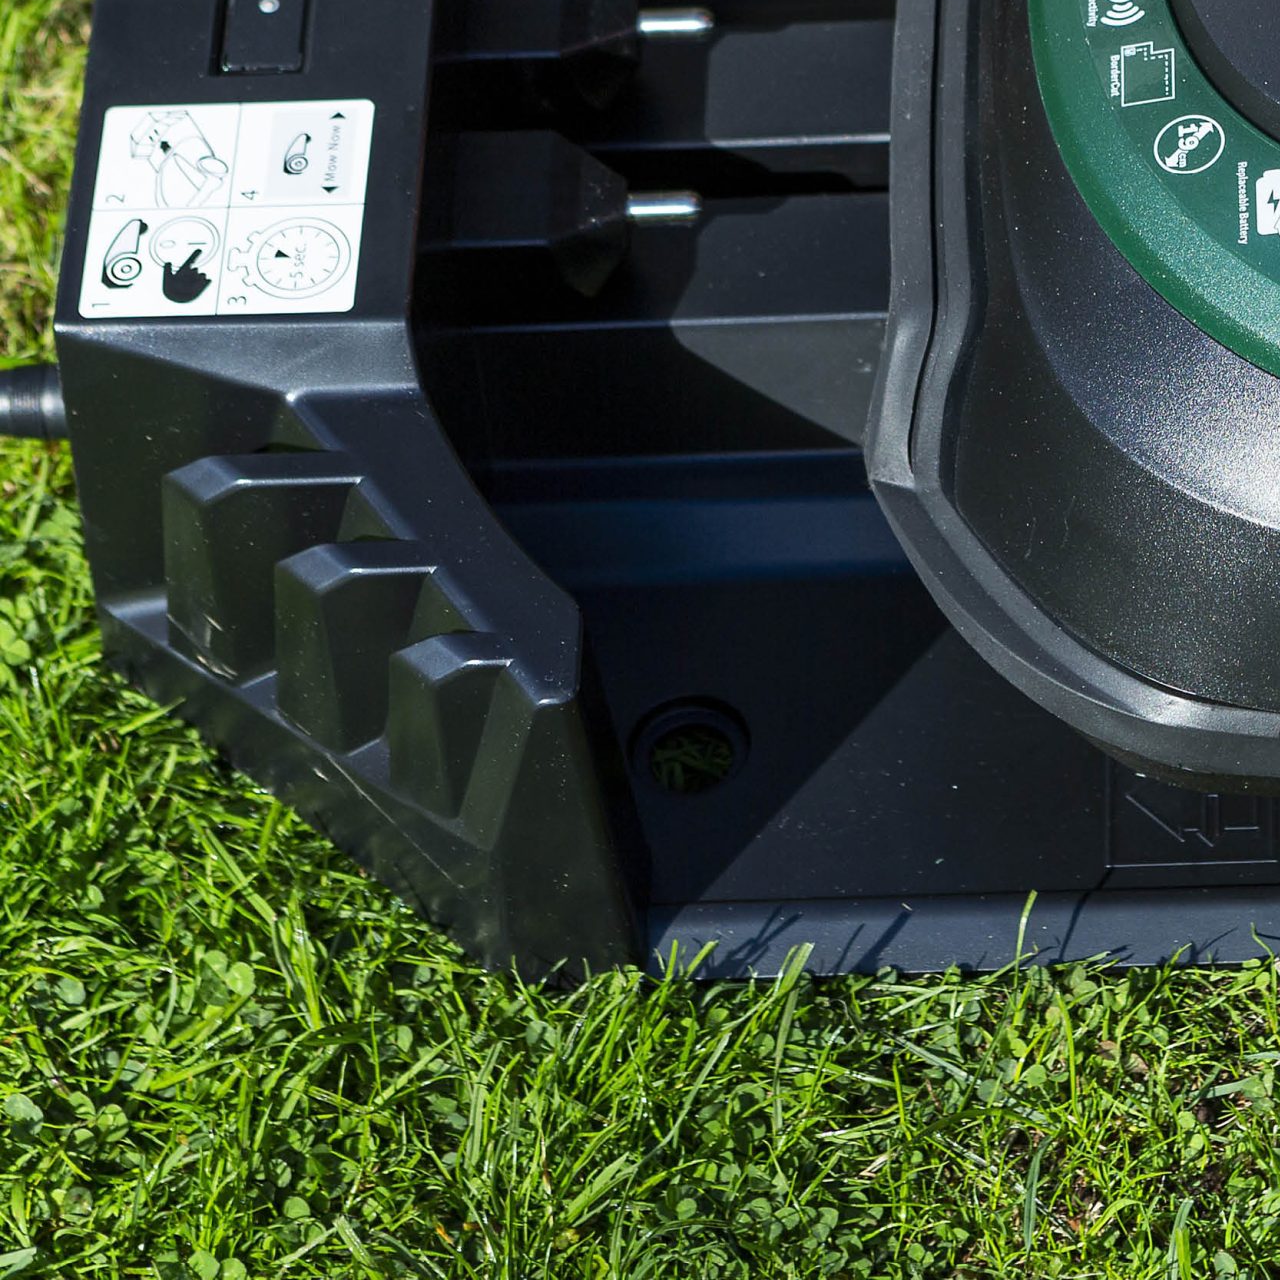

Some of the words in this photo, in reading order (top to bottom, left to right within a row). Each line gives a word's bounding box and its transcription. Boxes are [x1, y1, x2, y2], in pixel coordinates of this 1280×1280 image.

[1110, 54, 1121, 98] BorderCut
[1177, 123, 1200, 152] 19
[1177, 152, 1187, 168] cm
[240, 189, 259, 201] 4
[1237, 161, 1249, 213] Replaceable
[105, 194, 126, 203] 2
[1237, 213, 1250, 245] Battery
[227, 295, 248, 306] 3
